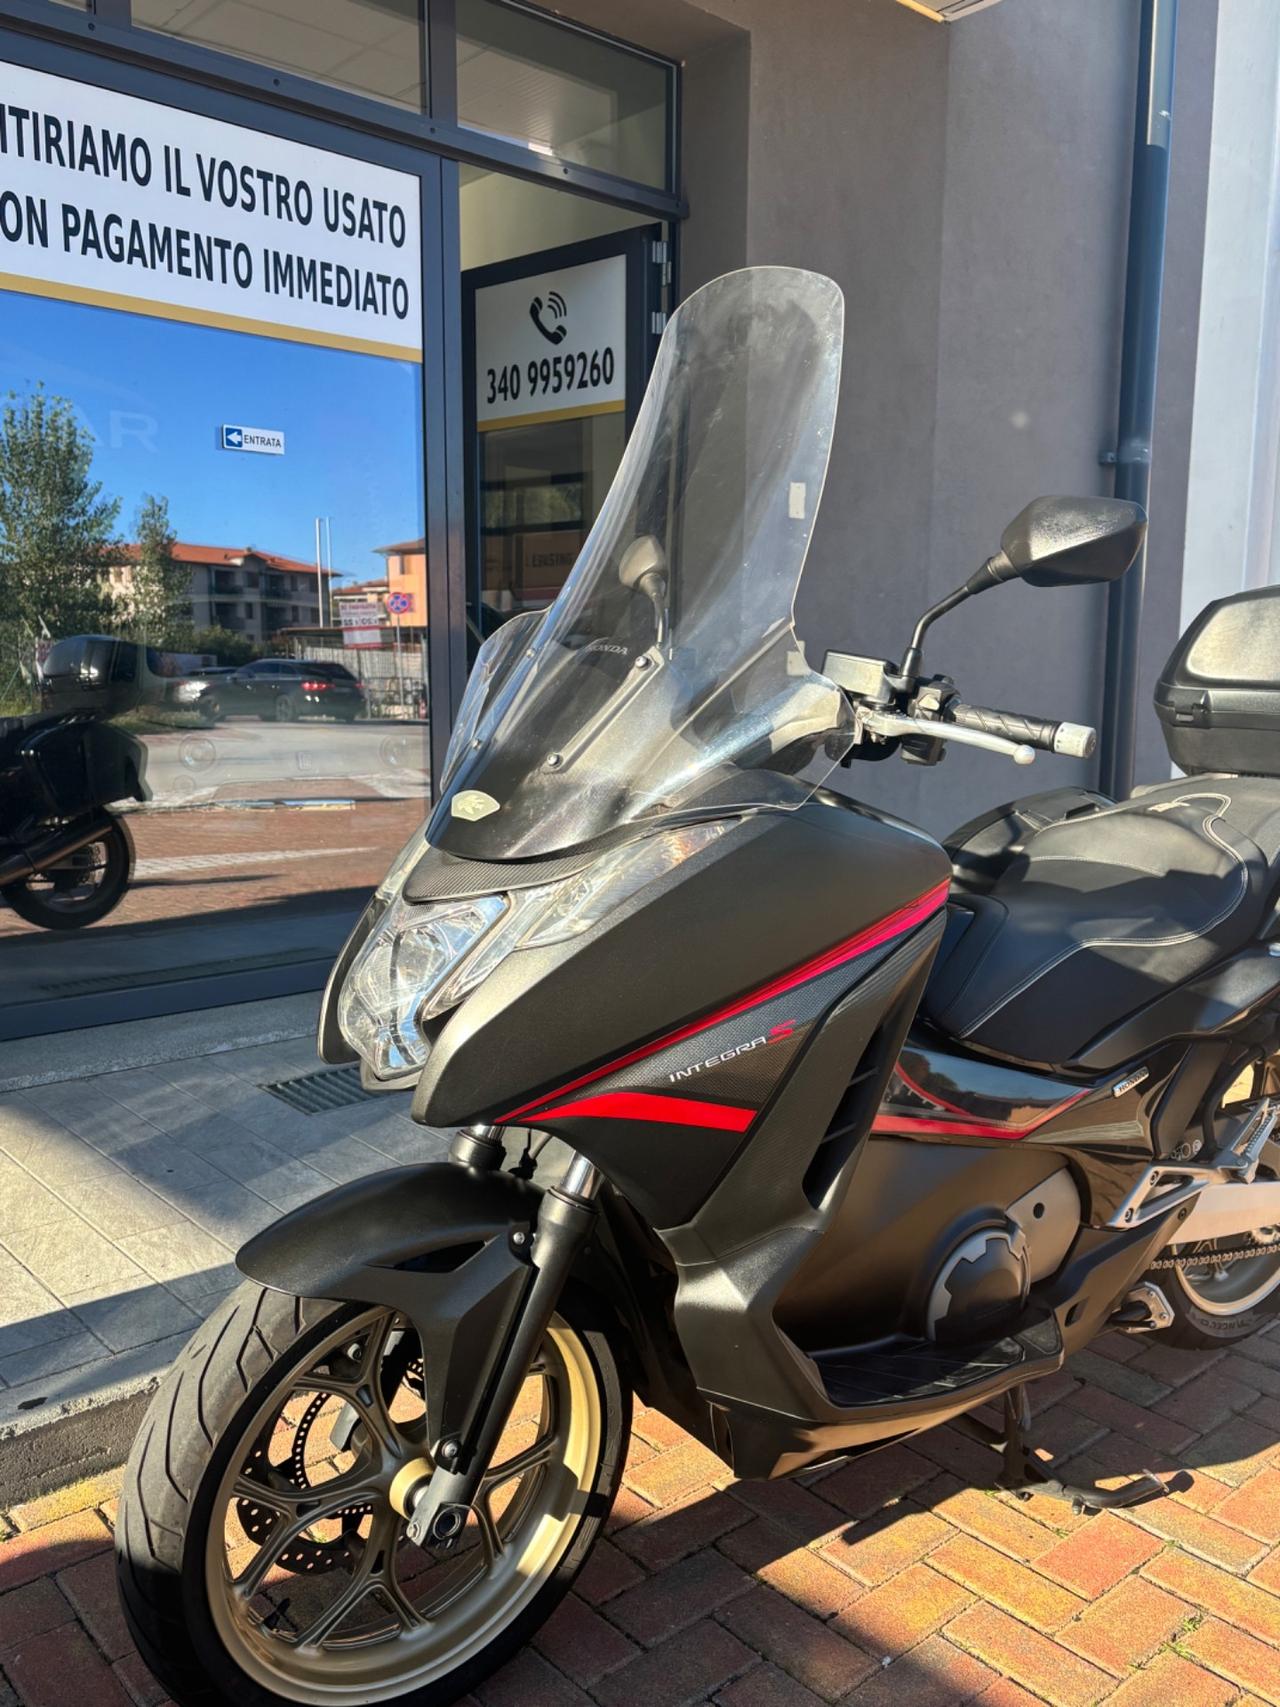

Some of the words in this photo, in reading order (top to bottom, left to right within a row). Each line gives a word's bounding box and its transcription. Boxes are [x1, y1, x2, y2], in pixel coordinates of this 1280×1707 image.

[0, 103, 152, 186] ITIRIAMO
[164, 145, 191, 198] IL
[196, 153, 313, 226] VOSTRO
[323, 187, 406, 248] USATO
[0, 190, 48, 248] ON
[62, 203, 253, 289] PAGAMENTO
[264, 248, 409, 320] IMMEDIATO
[487, 364, 520, 404] 340
[527, 346, 614, 396] 9959260
[243, 434, 282, 448] ENTRATA
[669, 1036, 767, 1082] INTEGRA
